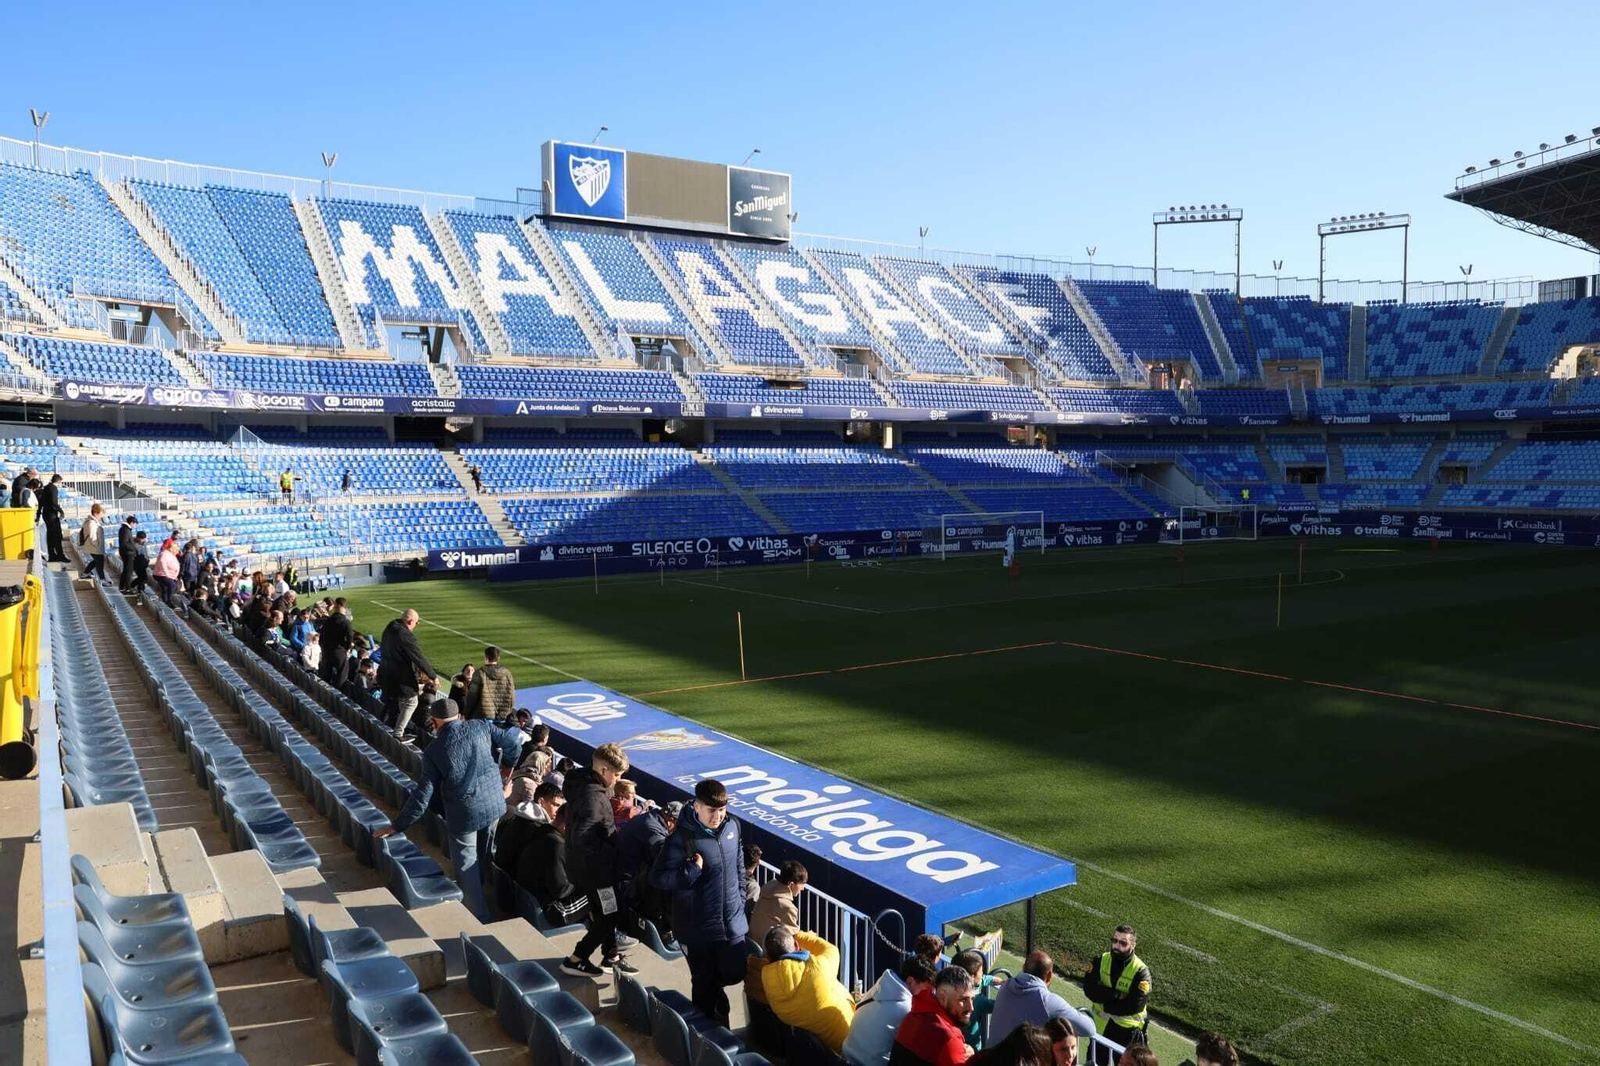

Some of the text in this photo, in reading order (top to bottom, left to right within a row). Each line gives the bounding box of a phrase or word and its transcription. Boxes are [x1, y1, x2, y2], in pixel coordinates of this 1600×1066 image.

[342, 397, 384, 408] campano
[412, 399, 455, 408] acristalia
[764, 406, 803, 415] divina events
[1181, 417, 1207, 425] vithas
[1333, 414, 1370, 423] hummel
[1411, 412, 1450, 422] hummel
[1303, 525, 1341, 535] vithas
[1514, 520, 1556, 530] CaixaBank
[747, 536, 788, 550] vithas
[1076, 535, 1102, 545] vithas
[558, 544, 613, 555] divina events
[632, 540, 693, 556] SILENCE
[461, 549, 519, 567] hummel
